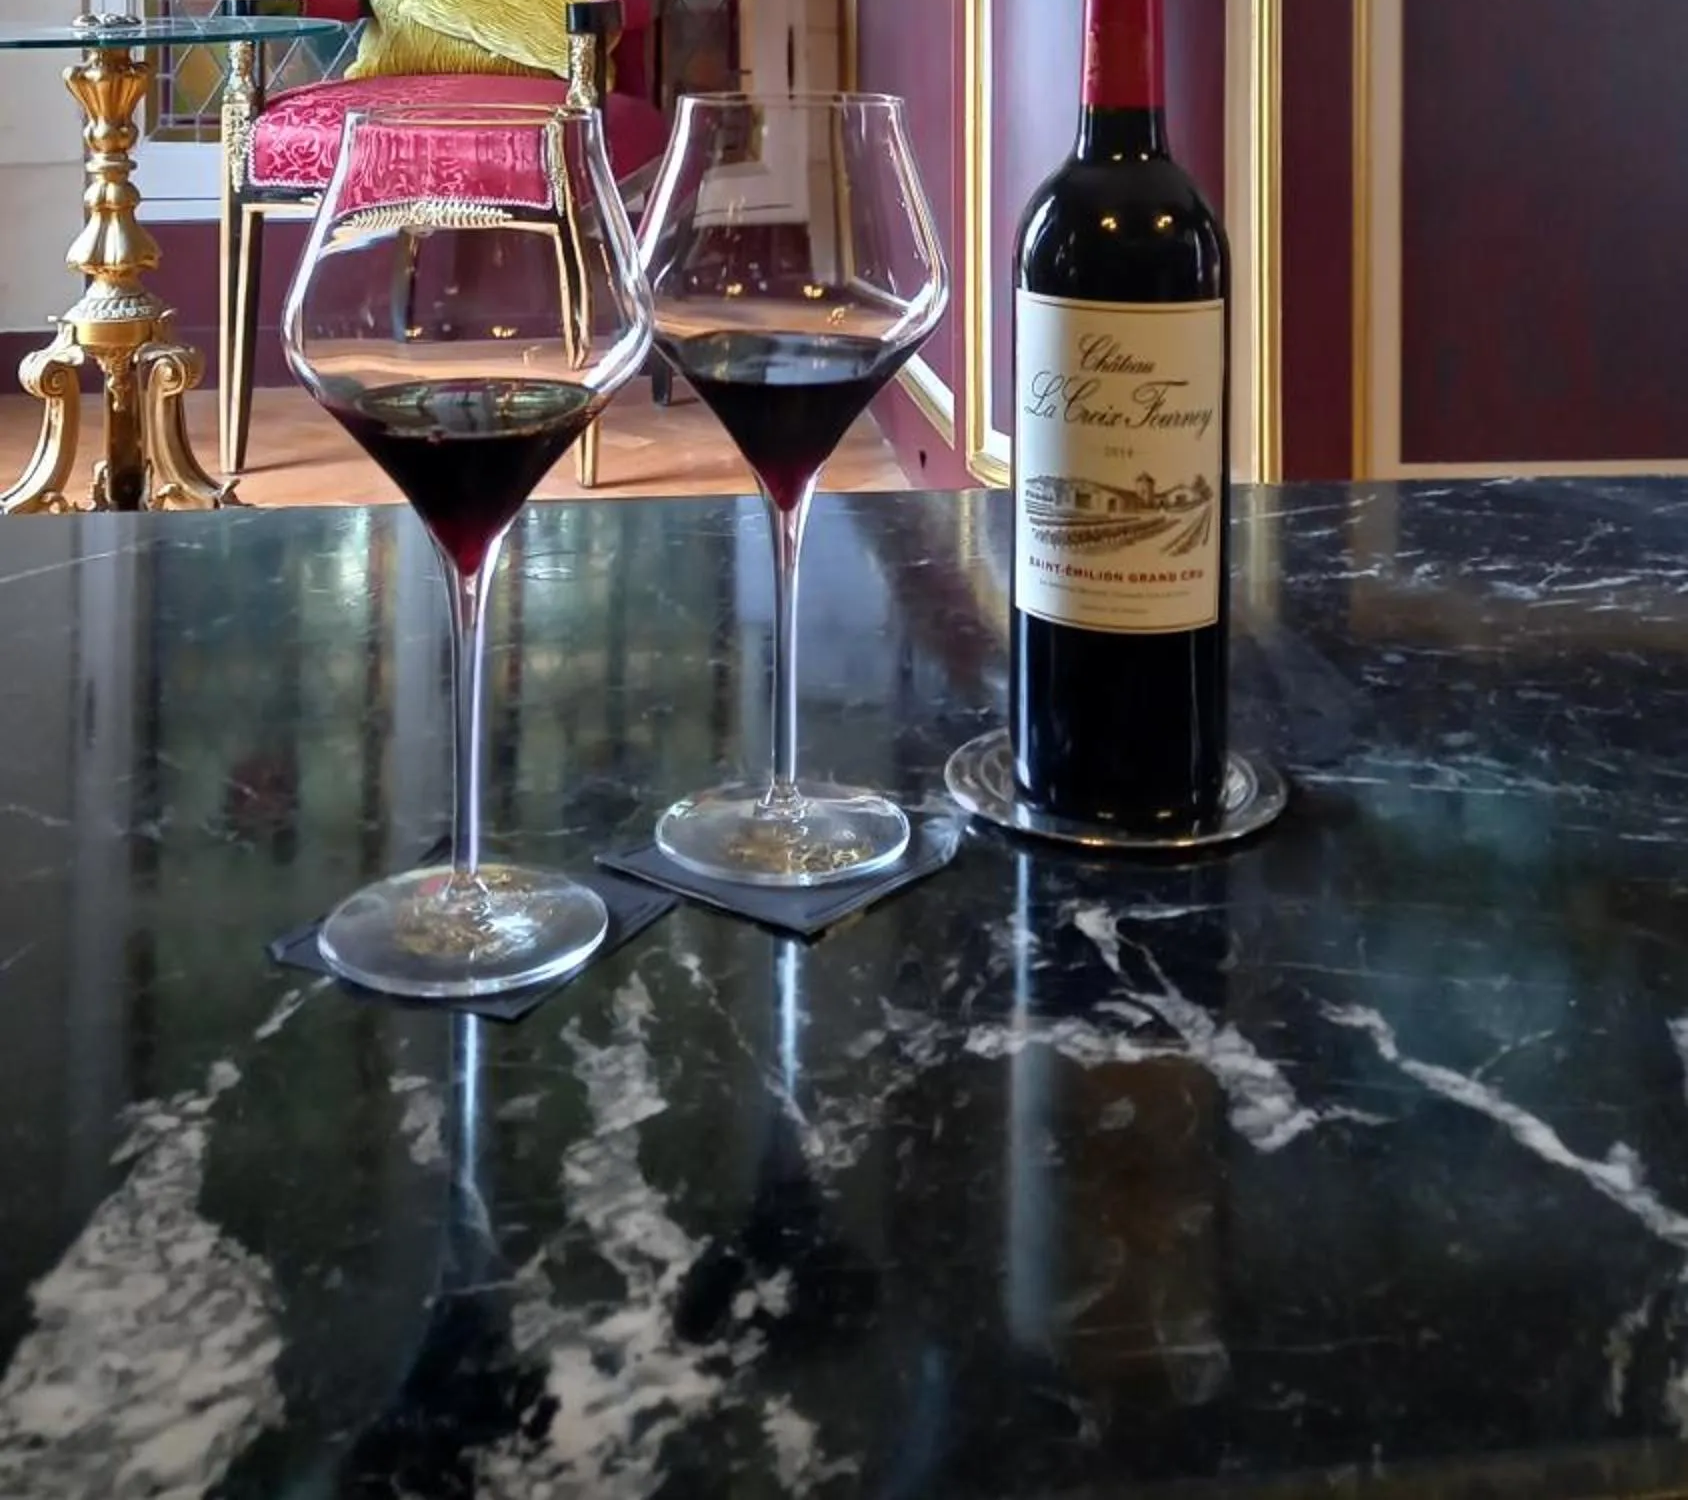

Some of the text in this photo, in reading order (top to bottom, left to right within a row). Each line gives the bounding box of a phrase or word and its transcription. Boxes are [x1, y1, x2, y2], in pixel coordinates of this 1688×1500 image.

[1078, 333, 1155, 373] Château
[1024, 371, 1212, 441] La Croix Fourney
[1029, 555, 1204, 583] SAINT-ÉMILION GRAND CRU
